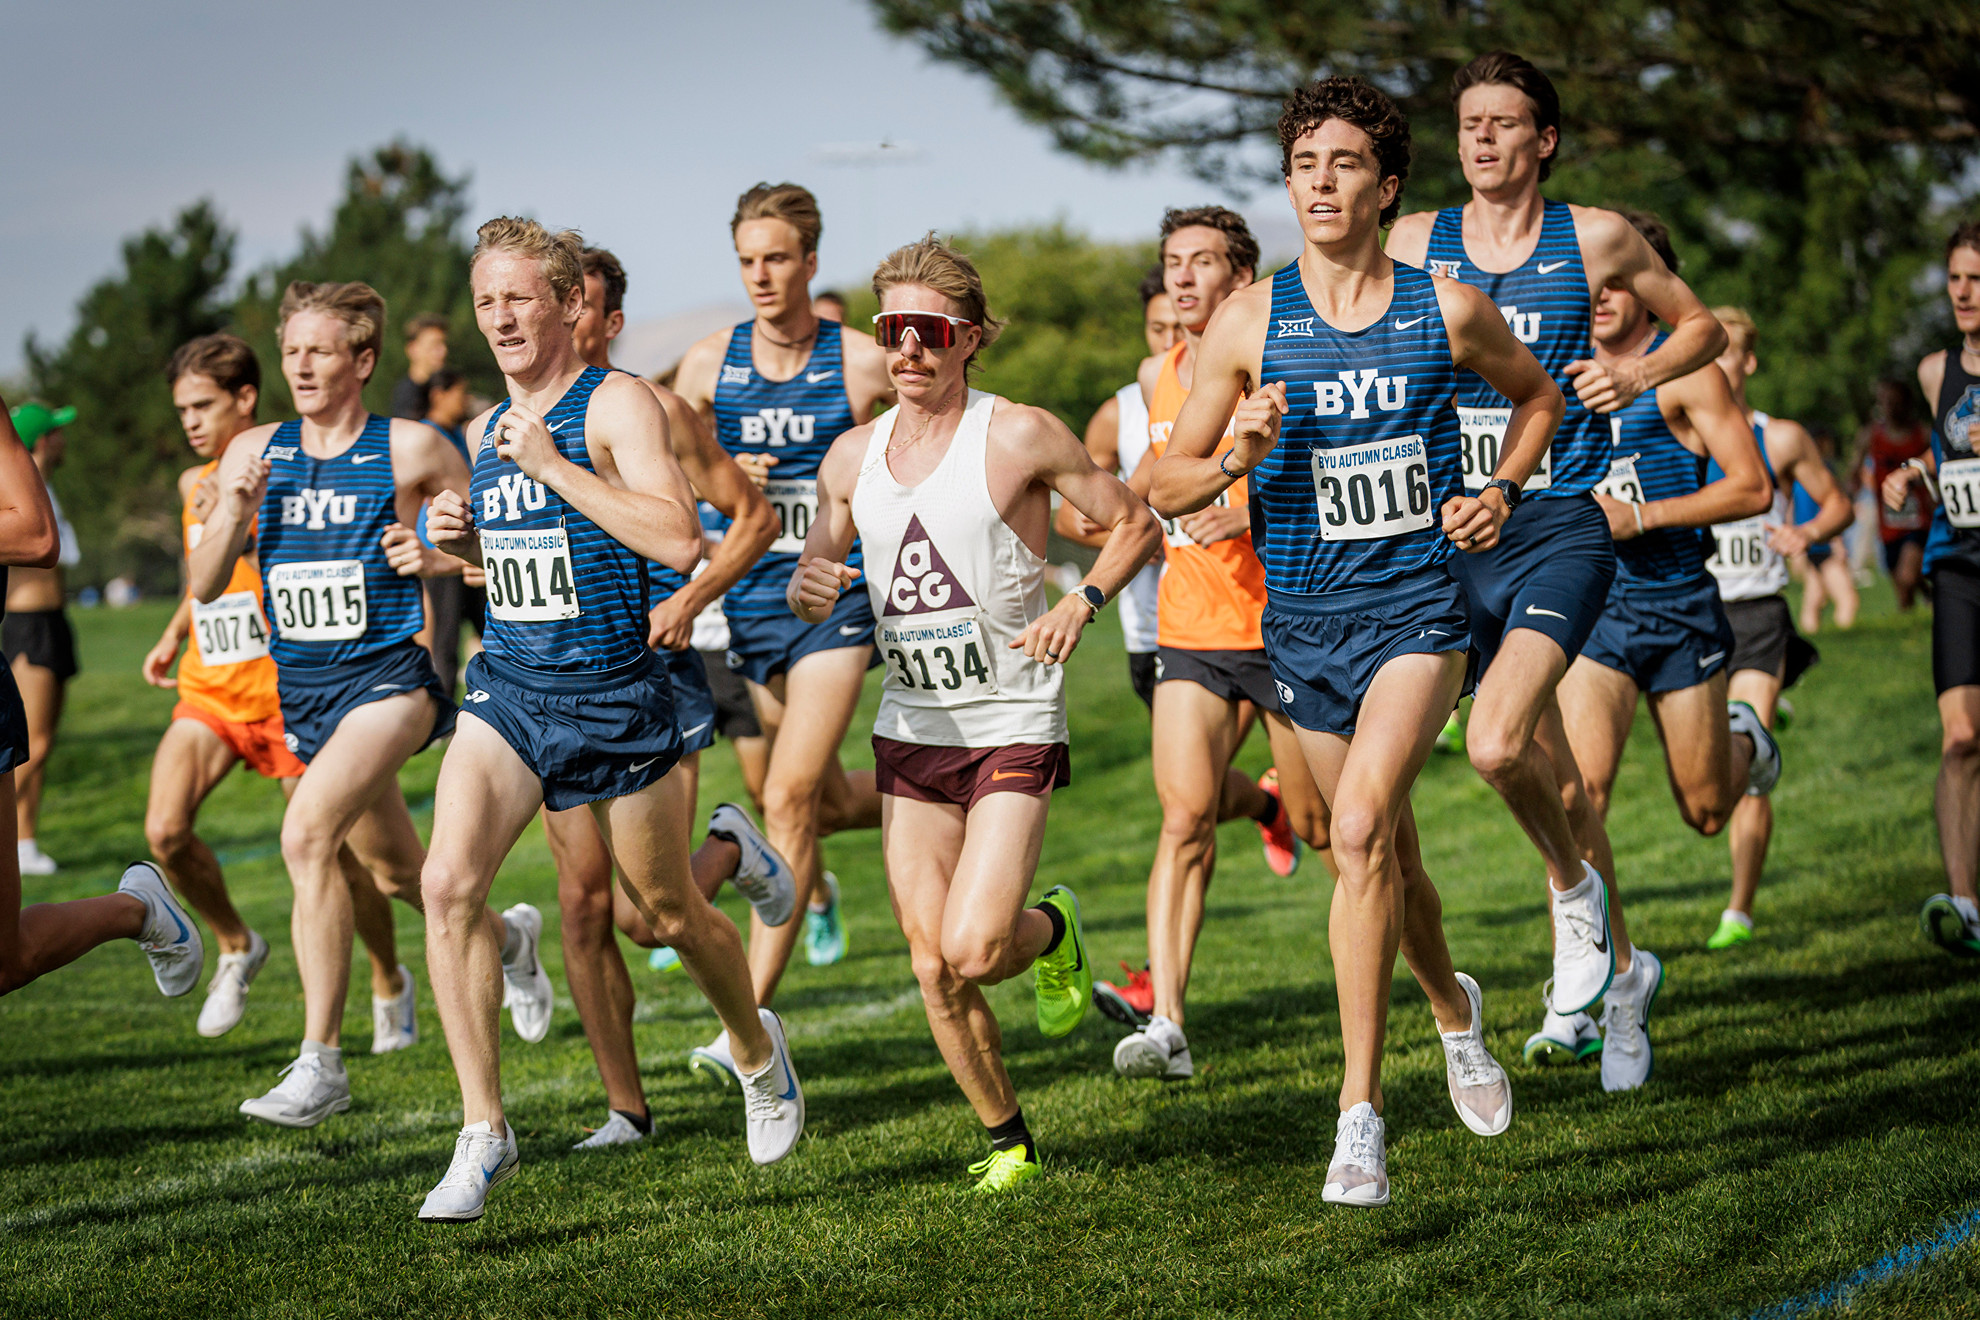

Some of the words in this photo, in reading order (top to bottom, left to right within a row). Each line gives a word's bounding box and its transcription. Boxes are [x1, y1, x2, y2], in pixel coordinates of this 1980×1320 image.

[1313, 369, 1408, 419] BYU
[740, 408, 816, 446] BYU
[1319, 456, 1336, 469] BYU
[1339, 449, 1380, 469] AUTUMN
[1382, 441, 1422, 461] CLASSIC
[281, 488, 357, 530] BYU
[483, 472, 546, 521] BYU
[1321, 463, 1429, 526] 3016
[495, 537, 527, 551] AUTUMN
[528, 535, 564, 550] CLASSIC
[293, 569, 323, 580] AUTUMN
[326, 566, 359, 578] CLASSIC
[487, 556, 574, 607] 3014
[278, 585, 361, 628] 3015
[200, 614, 266, 654] 3074
[884, 630, 898, 642] BYU
[900, 629, 935, 642] AUTUMN
[936, 622, 974, 640] CLASSIC
[888, 642, 989, 690] 3134
